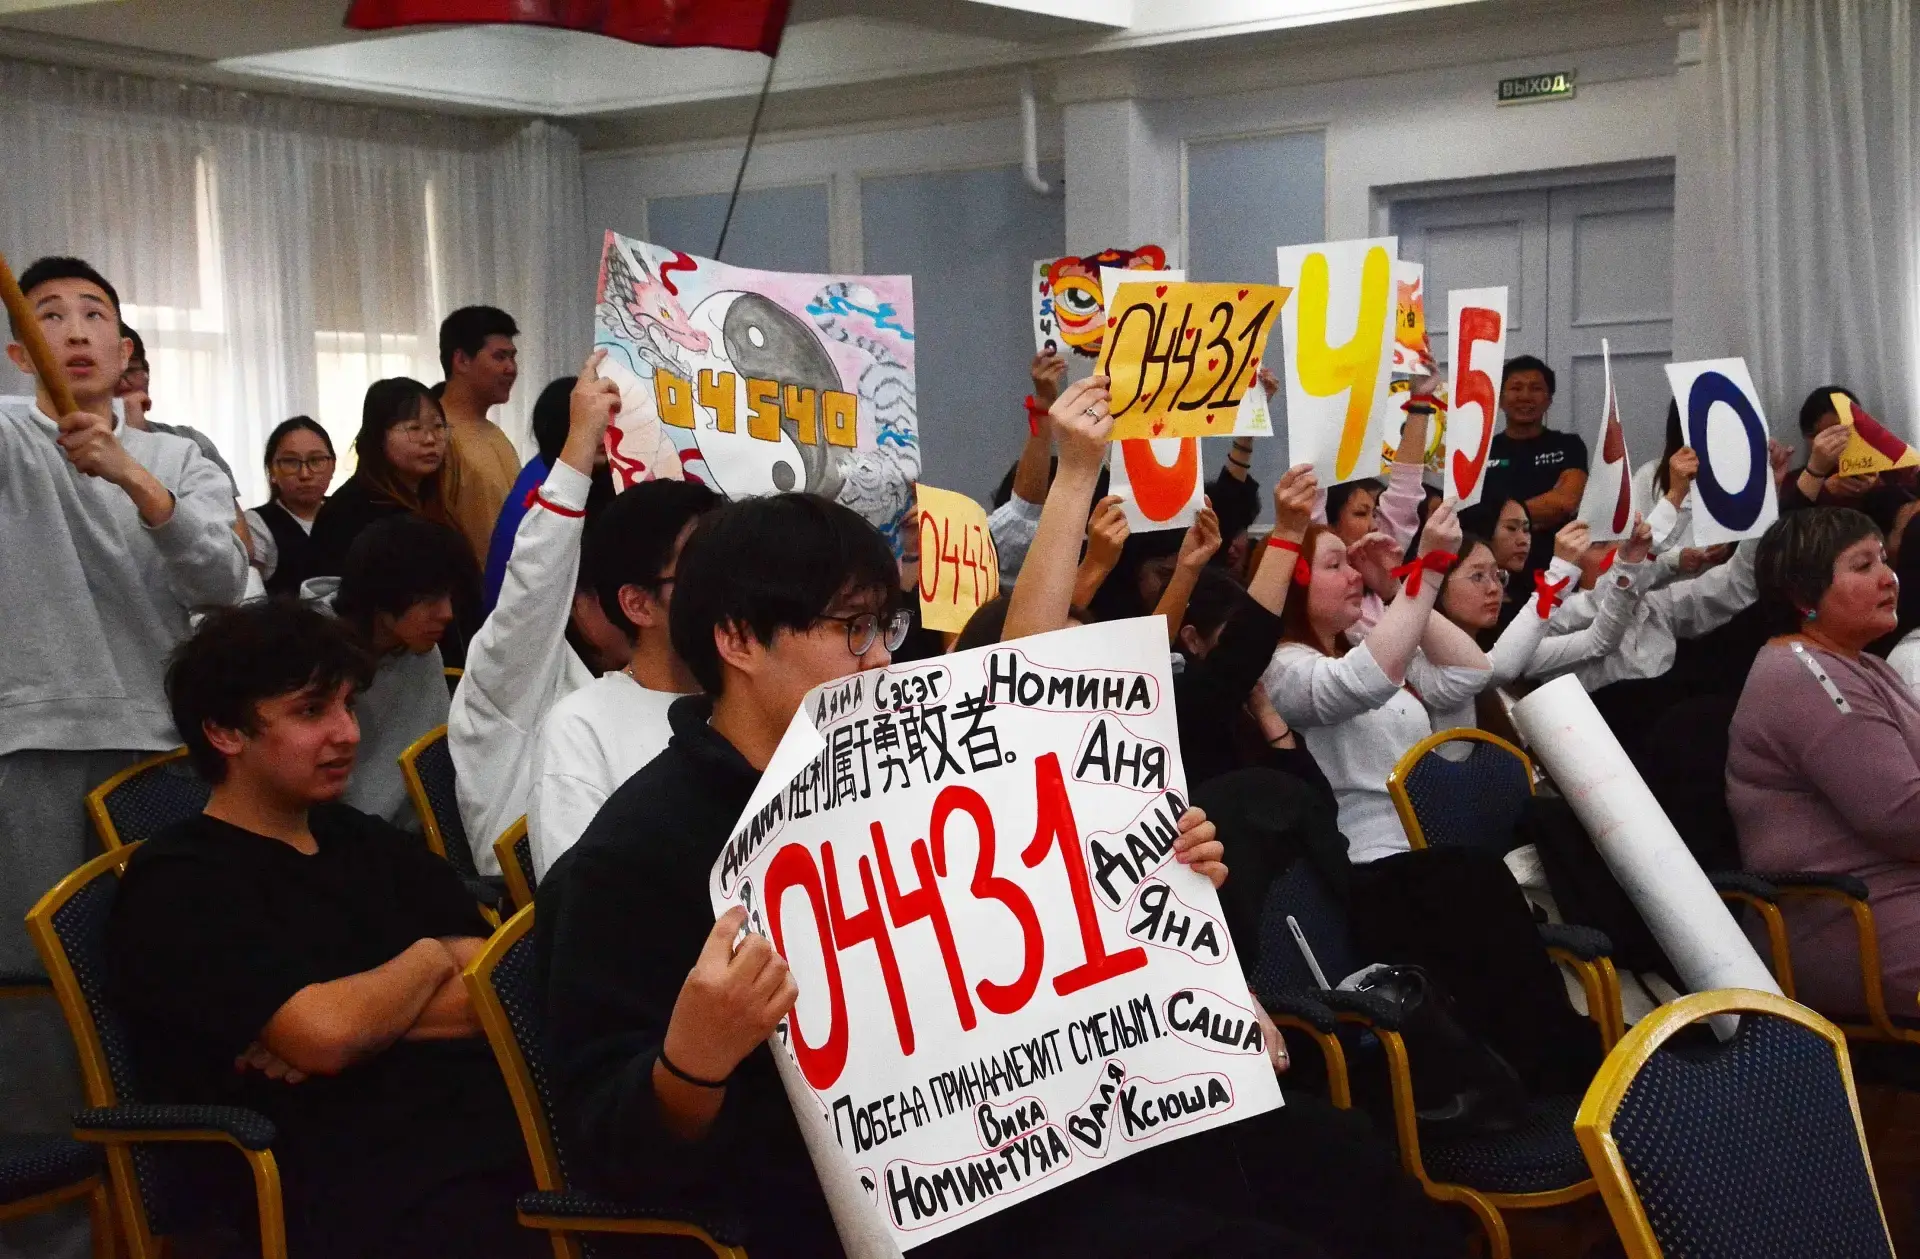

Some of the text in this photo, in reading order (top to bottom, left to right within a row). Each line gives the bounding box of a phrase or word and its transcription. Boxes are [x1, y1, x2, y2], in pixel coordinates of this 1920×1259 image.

[1502, 74, 1566, 97] ВЫХОД
[653, 367, 858, 448] 04540
[1105, 300, 1275, 419] 04431
[1296, 245, 1390, 481] 4
[1452, 307, 1502, 500] 5
[764, 752, 1149, 1090] 04431
